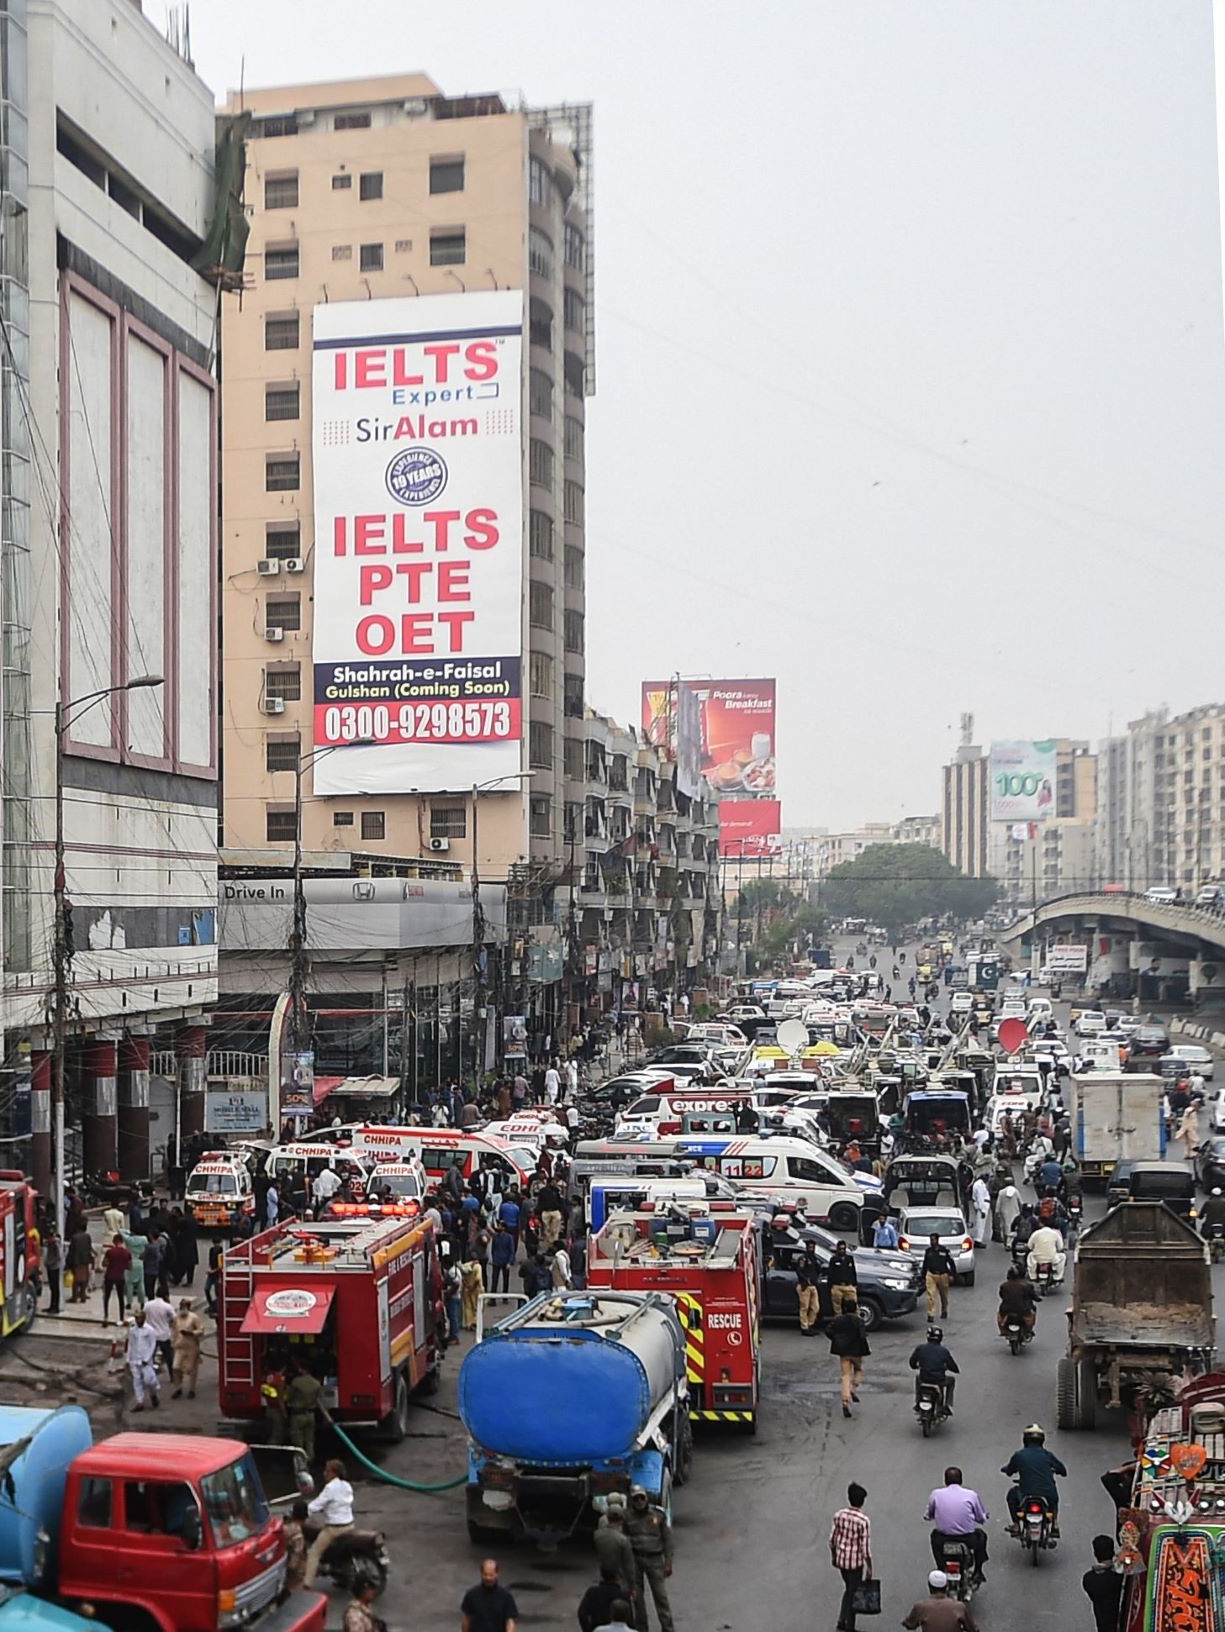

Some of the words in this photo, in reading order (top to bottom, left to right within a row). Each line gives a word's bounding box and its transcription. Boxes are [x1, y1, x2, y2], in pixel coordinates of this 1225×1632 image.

[334, 341, 499, 390] IELTS
[392, 384, 474, 407] Expert
[406, 463, 442, 486] YEARS
[334, 508, 500, 557] IELTS
[360, 560, 471, 606] PTE
[355, 611, 475, 656] OET
[333, 661, 501, 683] Shahrah-e-Faisal
[326, 683, 390, 699] Gulshan
[394, 681, 460, 699] (Coming
[464, 680, 510, 696] Soon)
[713, 690, 743, 700] Poora
[725, 698, 773, 709] Breakfast
[326, 702, 510, 740] 0300-9298573
[225, 886, 265, 900] Drive
[269, 885, 285, 899] In
[364, 1135, 402, 1146] CHHIPA
[295, 1147, 332, 1156] CHHIPA
[195, 1165, 233, 1174] CHHIPA
[376, 1167, 414, 1175] CHHIPA
[707, 1313, 742, 1329] RESCUE
